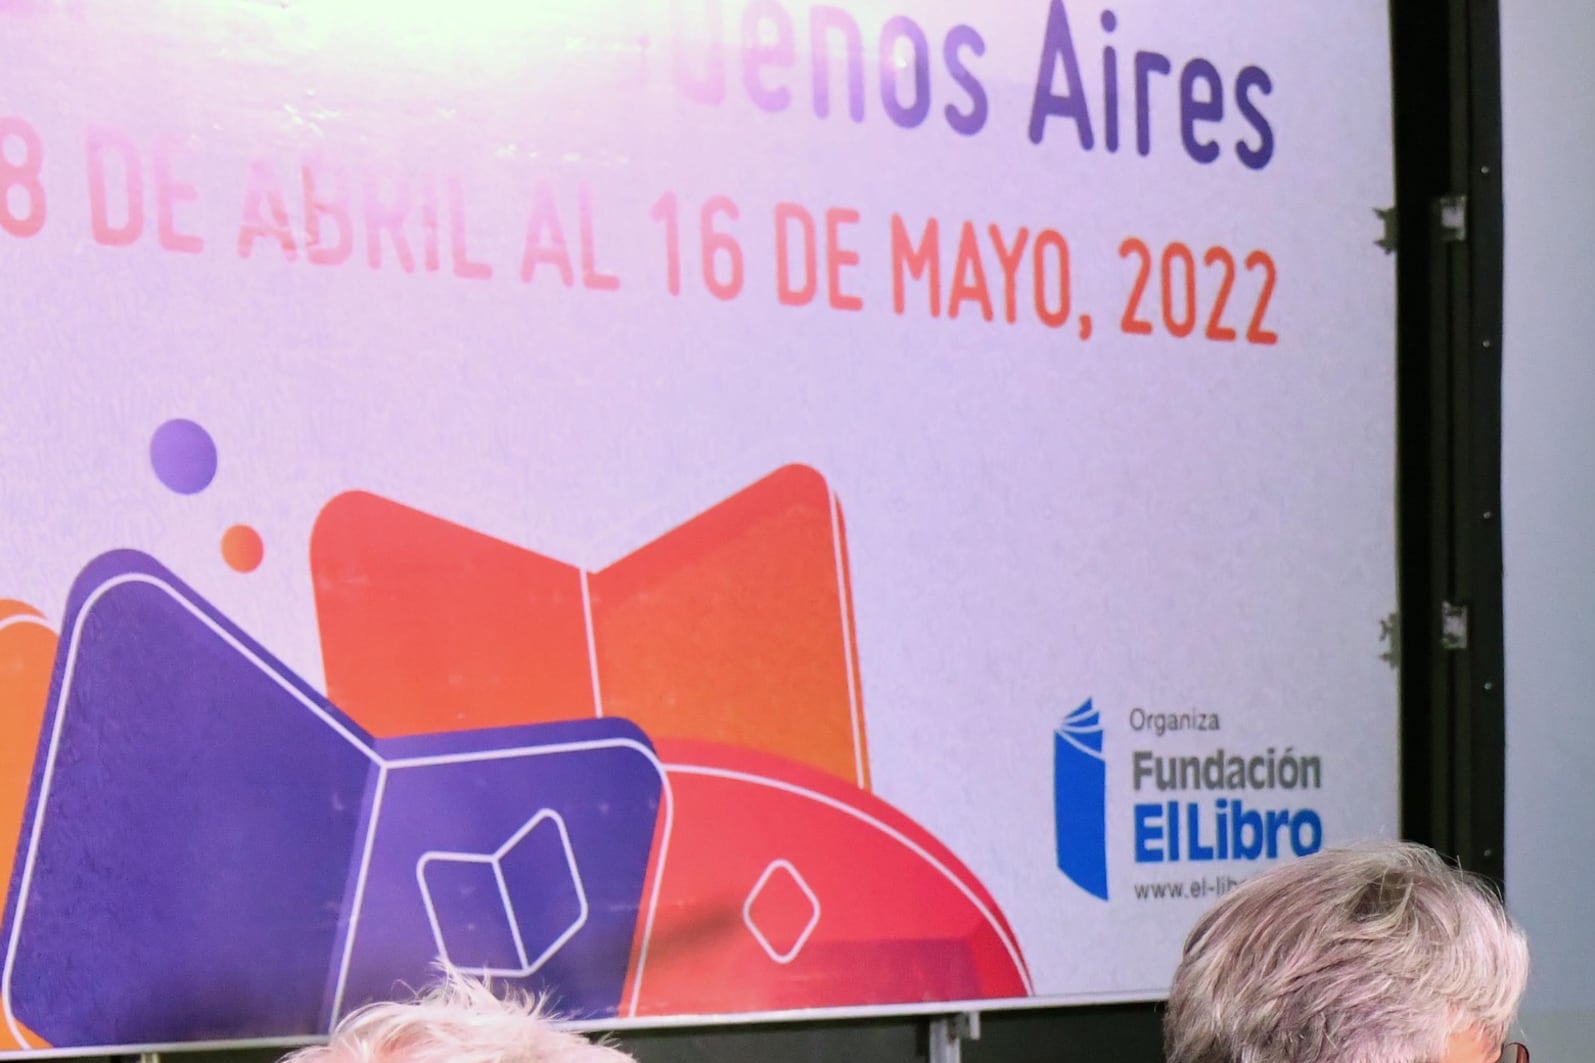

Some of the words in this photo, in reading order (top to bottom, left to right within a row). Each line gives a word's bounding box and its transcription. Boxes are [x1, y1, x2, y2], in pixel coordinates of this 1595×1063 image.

[672, 0, 990, 136] uenos
[1029, 0, 1275, 170] Aires
[85, 121, 205, 254] DE
[236, 155, 494, 281] ABRIL
[520, 177, 621, 291] AL
[649, 189, 744, 301] 16
[773, 201, 864, 311] DE
[891, 212, 1092, 341] MAYO,
[1118, 237, 1278, 345] 2022
[1129, 706, 1221, 737] Organiza
[1132, 747, 1322, 792] Fundación
